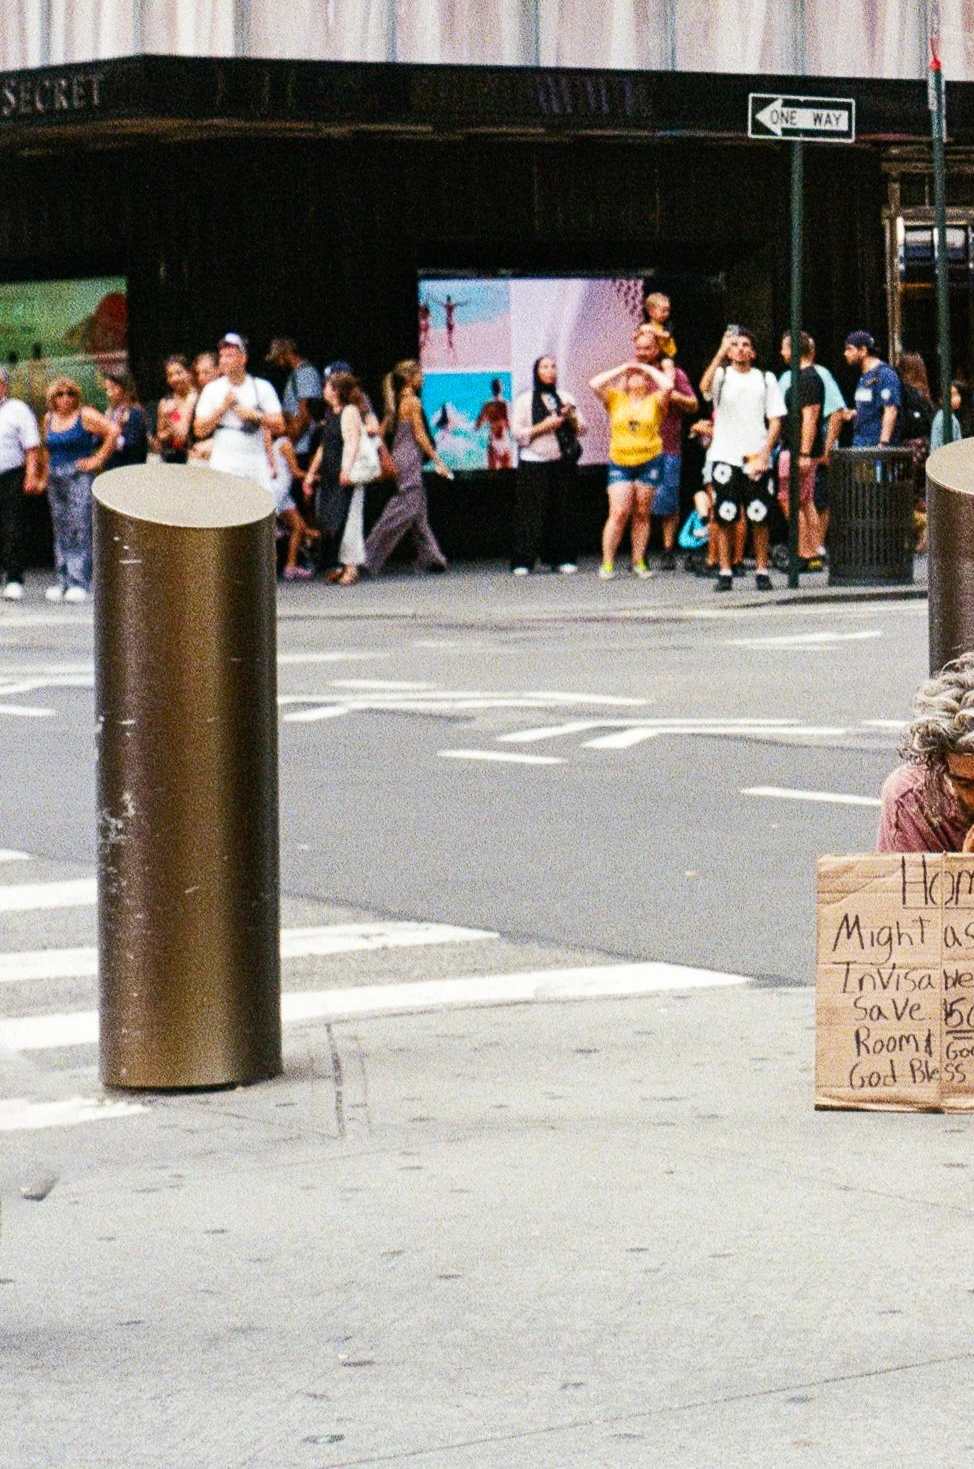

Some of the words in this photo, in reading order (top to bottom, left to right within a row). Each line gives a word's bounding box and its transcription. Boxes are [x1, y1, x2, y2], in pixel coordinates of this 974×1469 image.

[2, 75, 105, 116] SECRET
[770, 108, 797, 126] ONE
[813, 111, 842, 127] WAY
[850, 1059, 897, 1090] God
[909, 1058, 967, 1084] Bless
